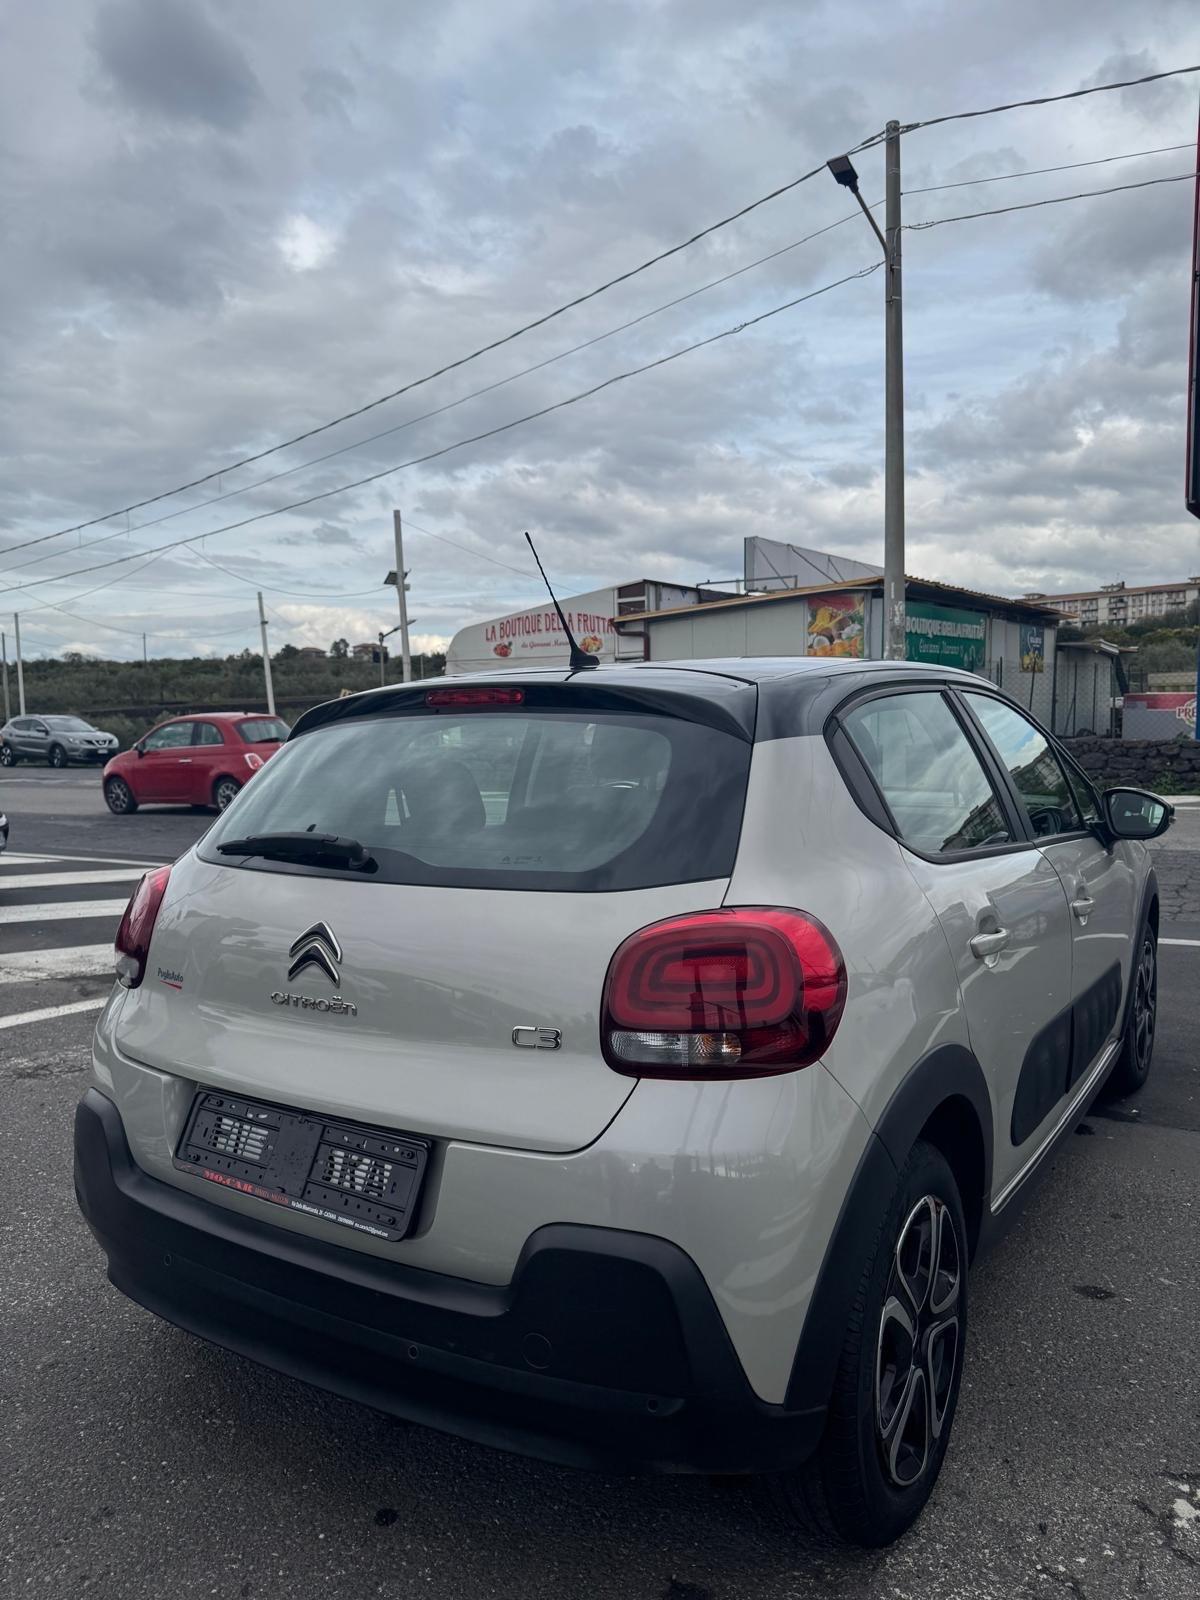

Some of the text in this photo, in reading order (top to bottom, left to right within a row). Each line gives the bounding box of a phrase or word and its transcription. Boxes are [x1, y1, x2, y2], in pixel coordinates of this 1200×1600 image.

[485, 612, 614, 641] LA BOUTIQUE DELA FRUTTA
[271, 991, 357, 1016] CITROËN
[512, 1025, 562, 1050] C3
